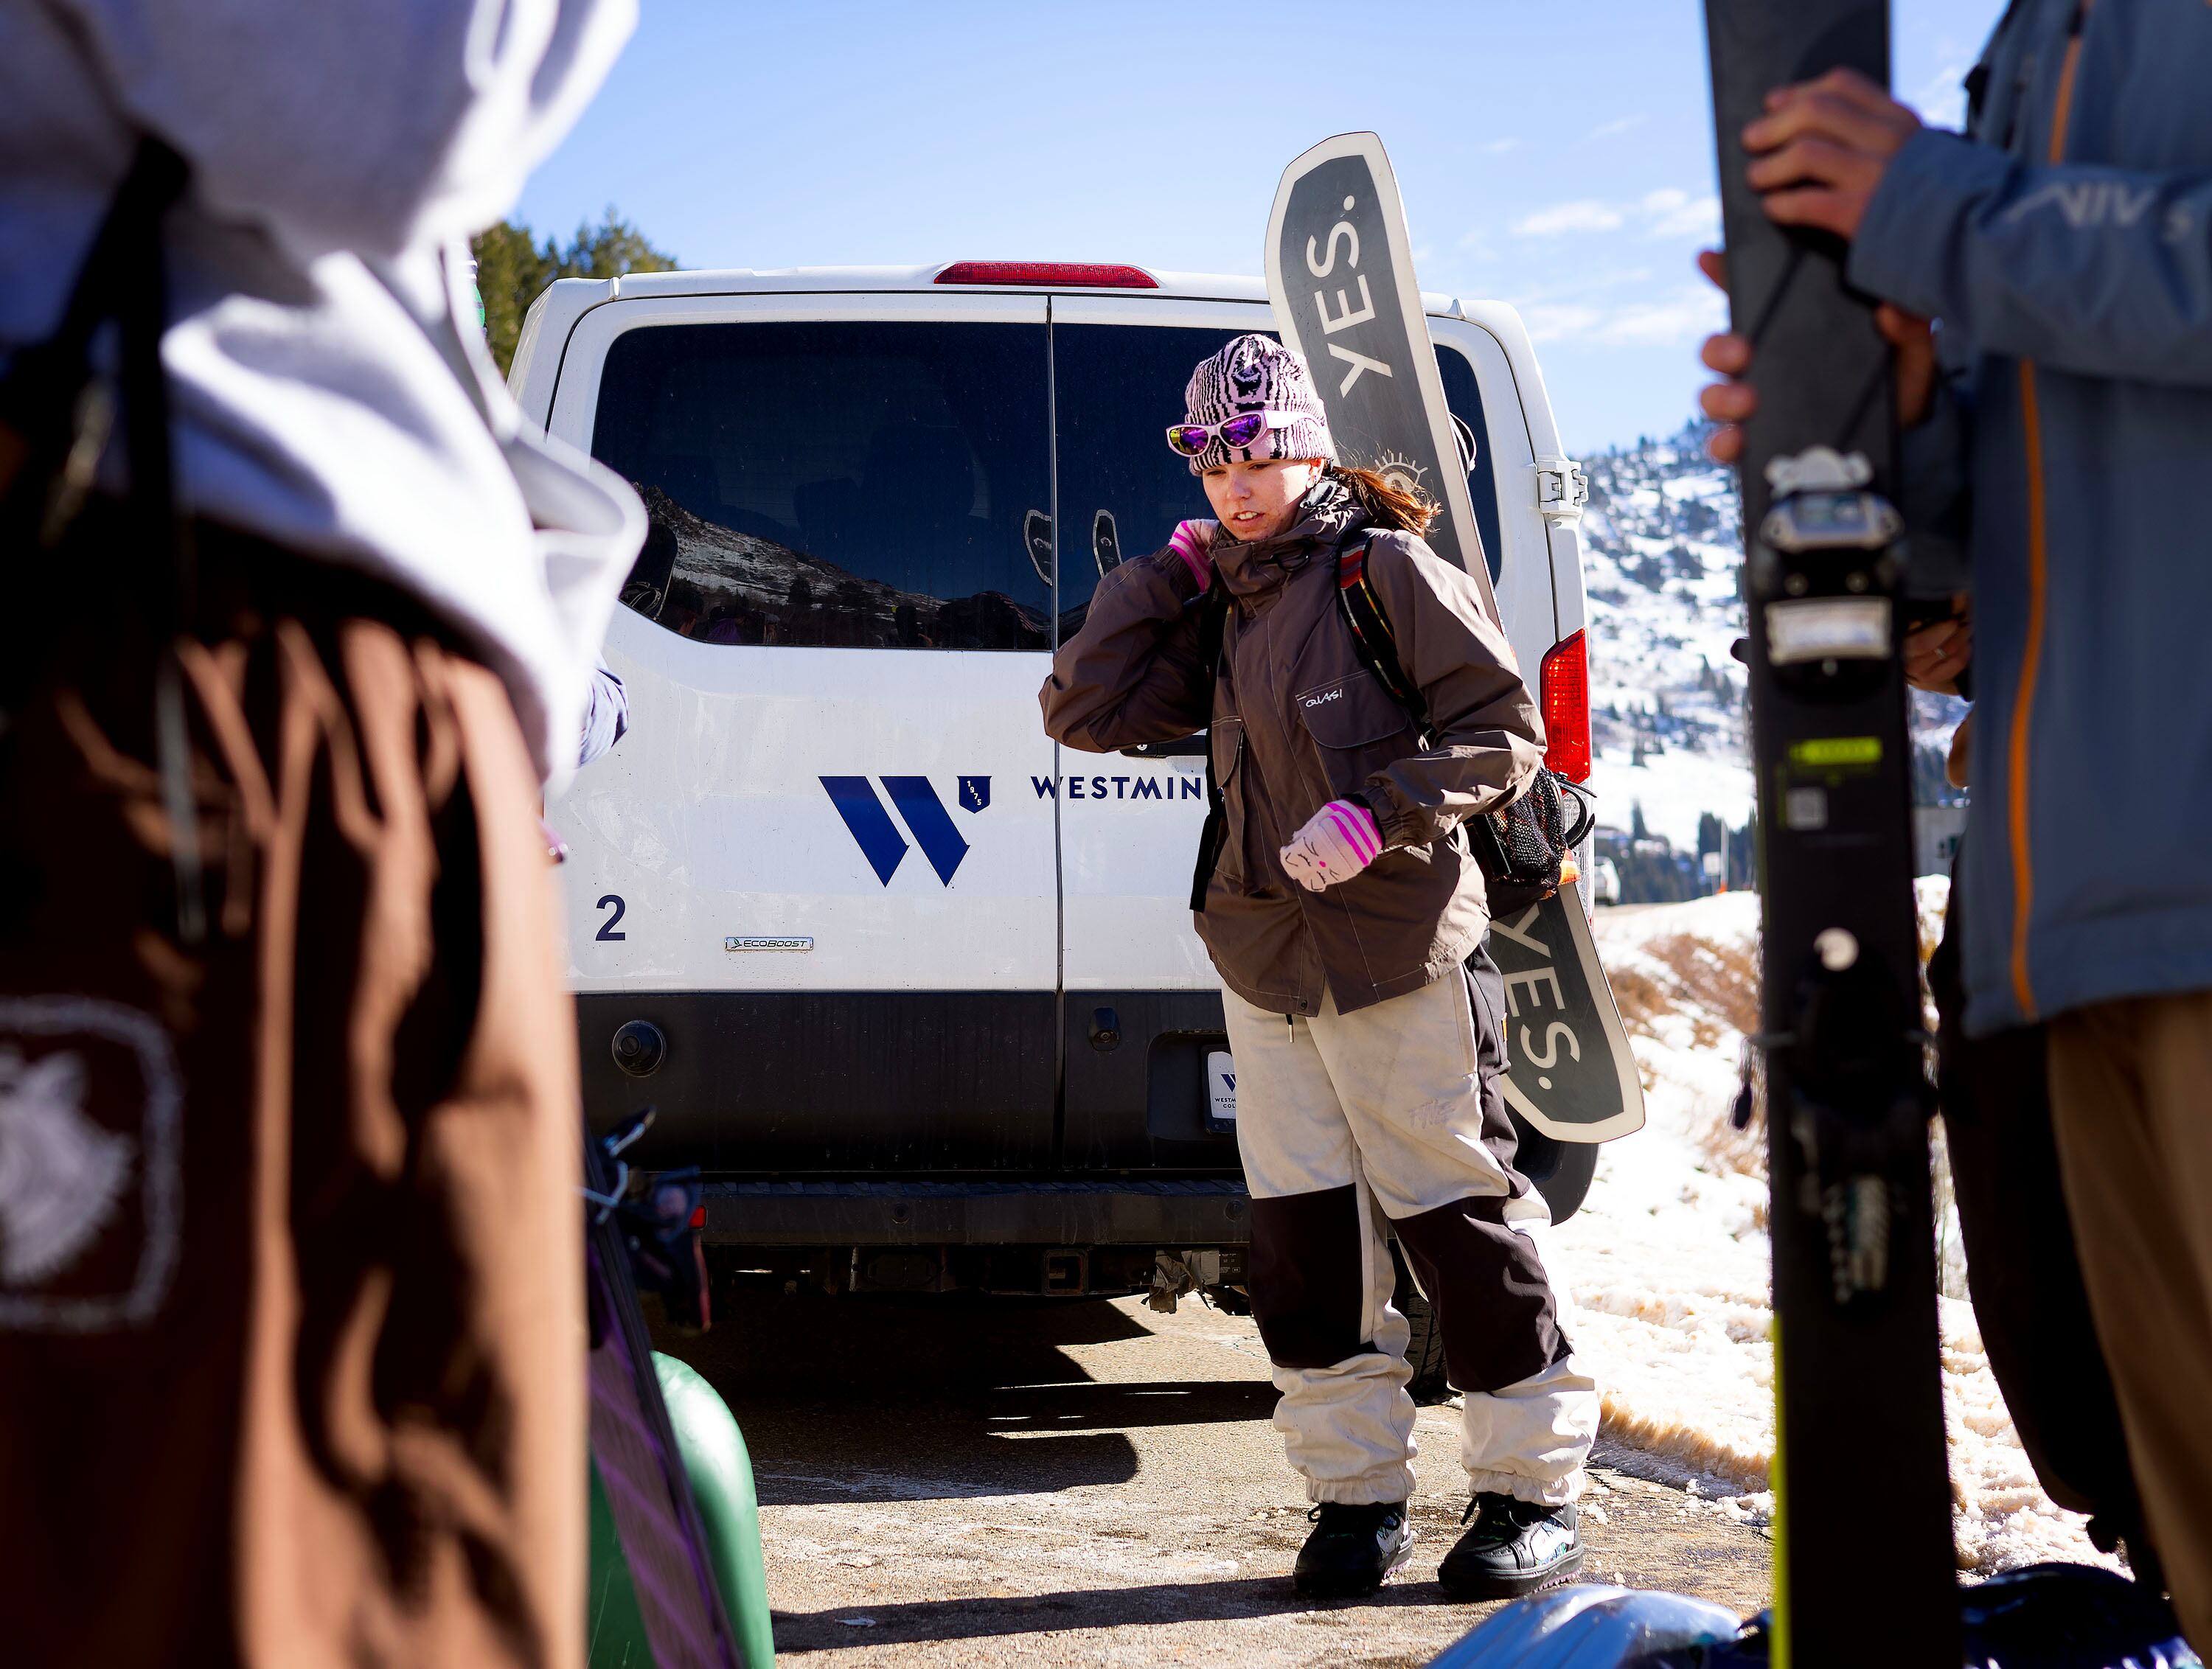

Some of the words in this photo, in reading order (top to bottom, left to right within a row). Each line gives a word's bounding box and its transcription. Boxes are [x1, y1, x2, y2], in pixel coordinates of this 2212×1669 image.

[1306, 195, 1393, 399] YES.
[967, 780, 982, 806] 1975
[1030, 776, 1223, 801] WESTMIN
[595, 894, 625, 941] 2
[1489, 902, 1580, 1090] YES.
